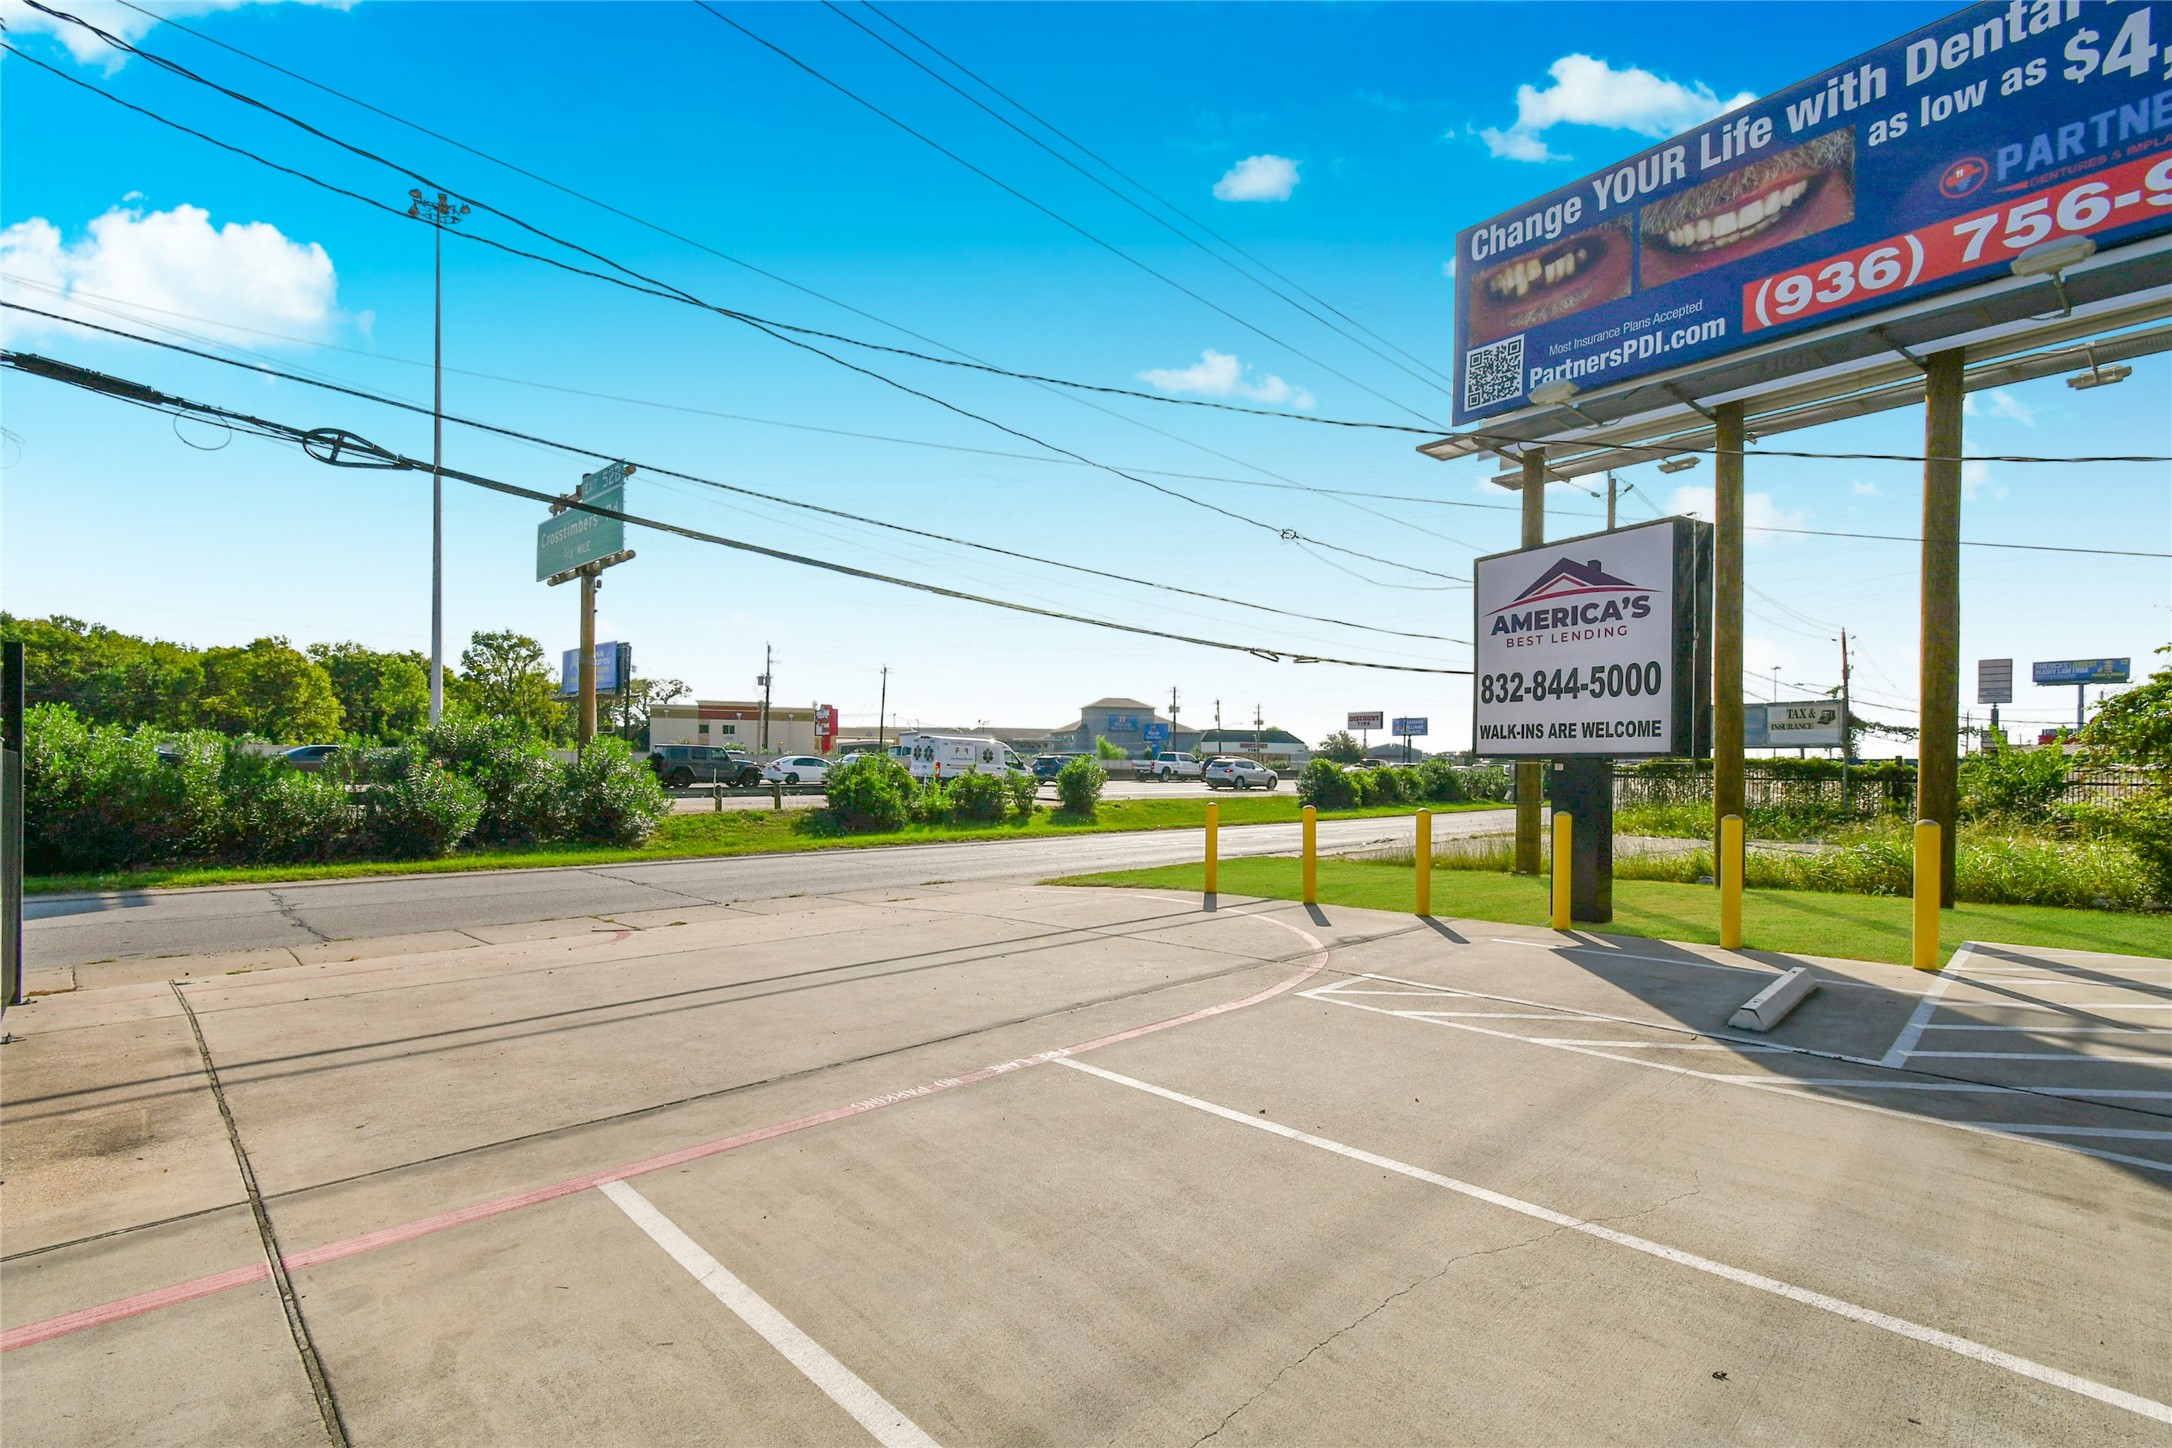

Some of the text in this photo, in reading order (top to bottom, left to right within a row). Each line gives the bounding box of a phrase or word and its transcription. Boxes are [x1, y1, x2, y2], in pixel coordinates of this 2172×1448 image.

[1868, 107, 1907, 146] as
[1919, 79, 1988, 127] low
[2000, 57, 2047, 96] as
[1471, 196, 1582, 262] Change
[1592, 145, 1686, 211] YOUR
[1700, 110, 1772, 172] Life
[1786, 63, 1887, 133] with
[2029, 155, 2108, 187] DENTURES
[1755, 237, 1926, 328] (936)
[1549, 299, 1704, 357] Most Insurance Plans Accepted
[1529, 316, 1726, 389] PartnersPDI.com
[584, 466, 622, 494] EXIT 52B
[541, 513, 599, 549] Crosstimbers
[1490, 595, 1652, 637] AMERICA'S
[1506, 625, 1628, 649] BEST LENDING
[1481, 661, 1662, 704] 832-844-5000
[1480, 719, 1663, 740] WALK-INS ARE WELCOME
[1771, 722, 1814, 731] INSURANCE
[1786, 708, 1816, 719] TAX &
[852, 1086, 931, 1110] PARKING
